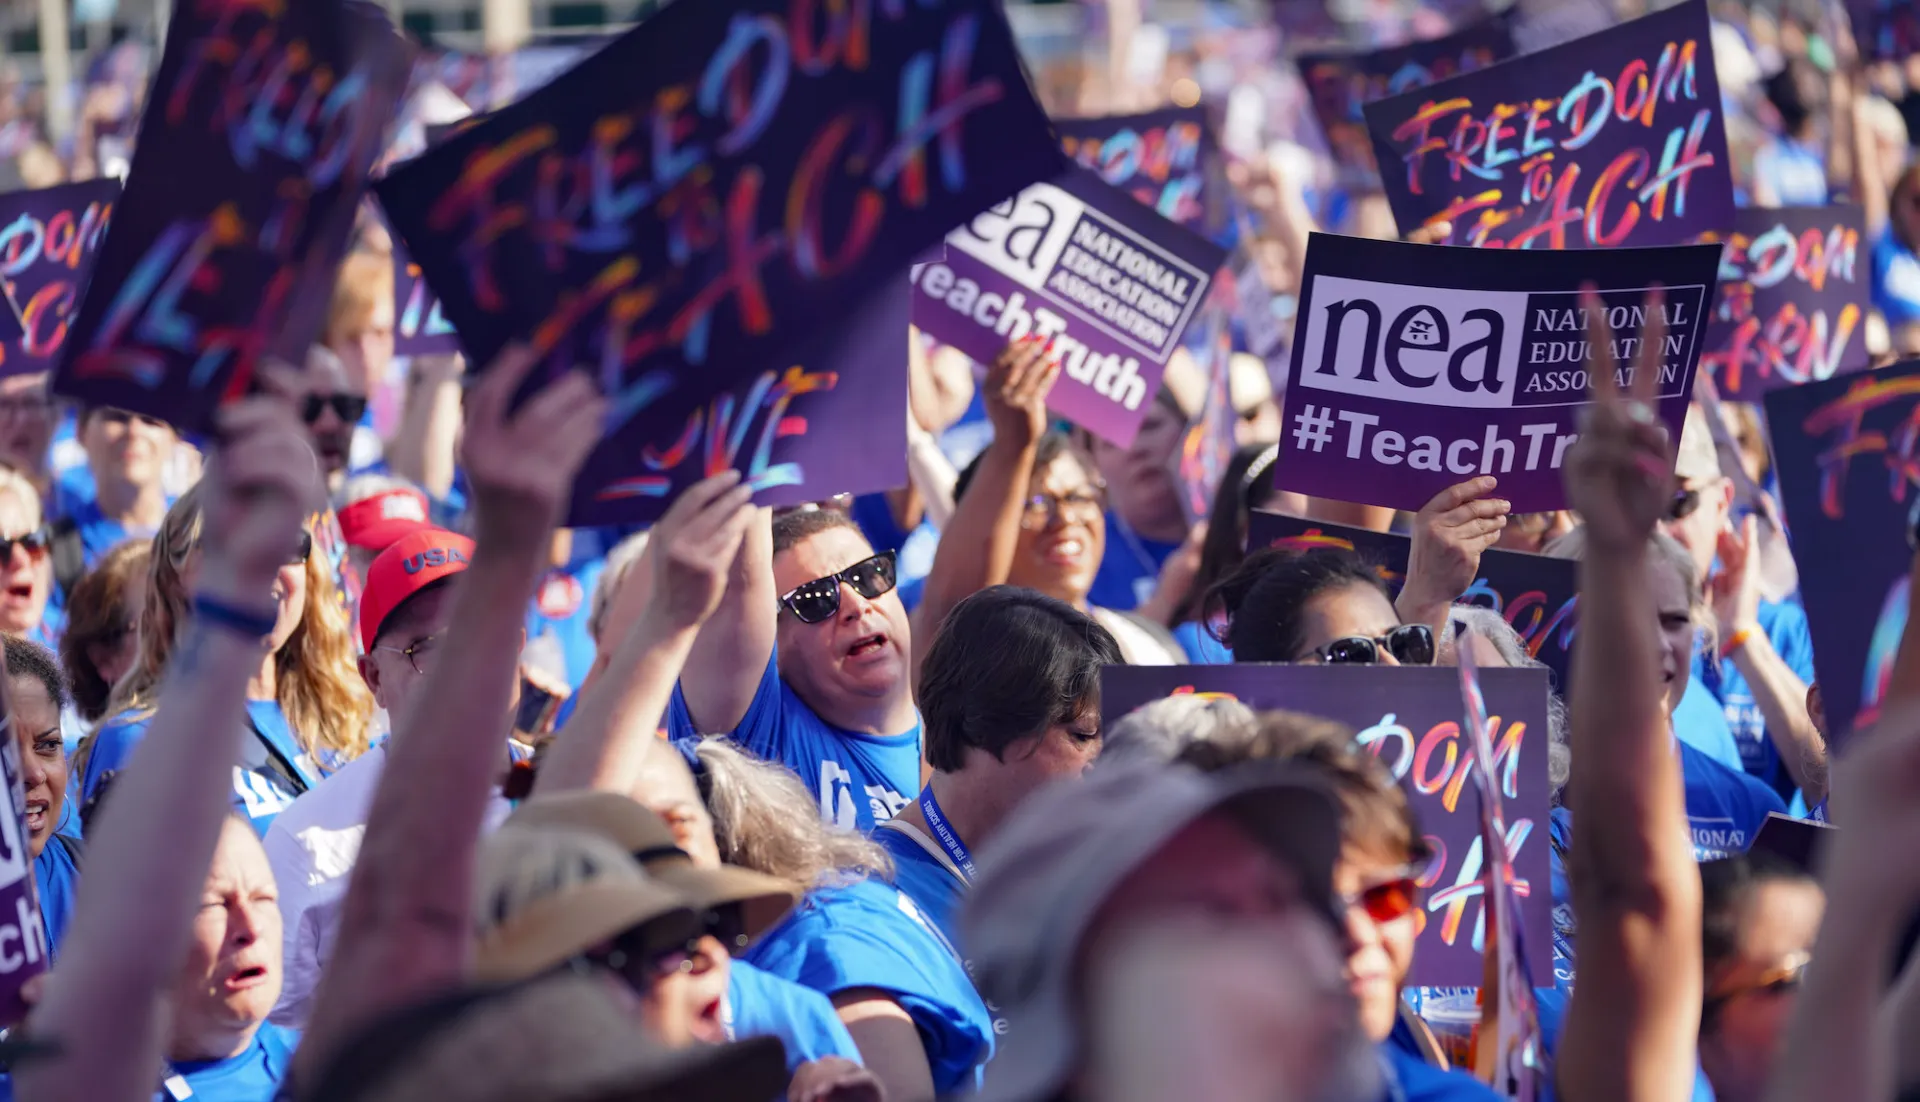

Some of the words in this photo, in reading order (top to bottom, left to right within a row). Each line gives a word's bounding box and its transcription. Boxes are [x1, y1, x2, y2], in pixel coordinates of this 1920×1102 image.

[1392, 39, 1698, 195] FREEDOM
[1520, 152, 1555, 205] TO
[1060, 244, 1183, 328] EDUCATION
[1071, 220, 1190, 303] NATIONAL
[1700, 223, 1859, 292] EDOM
[909, 262, 1147, 411] eachTruth
[1314, 297, 1506, 395] nea
[1700, 302, 1861, 393] ARN
[1524, 363, 1680, 393] ASSOCATN
[1292, 402, 1581, 474] #TeachTr
[402, 547, 469, 575] USA
[923, 799, 941, 826] SCHOOLS
[935, 823, 958, 850] HEALTHY
[953, 846, 966, 862] FOR
